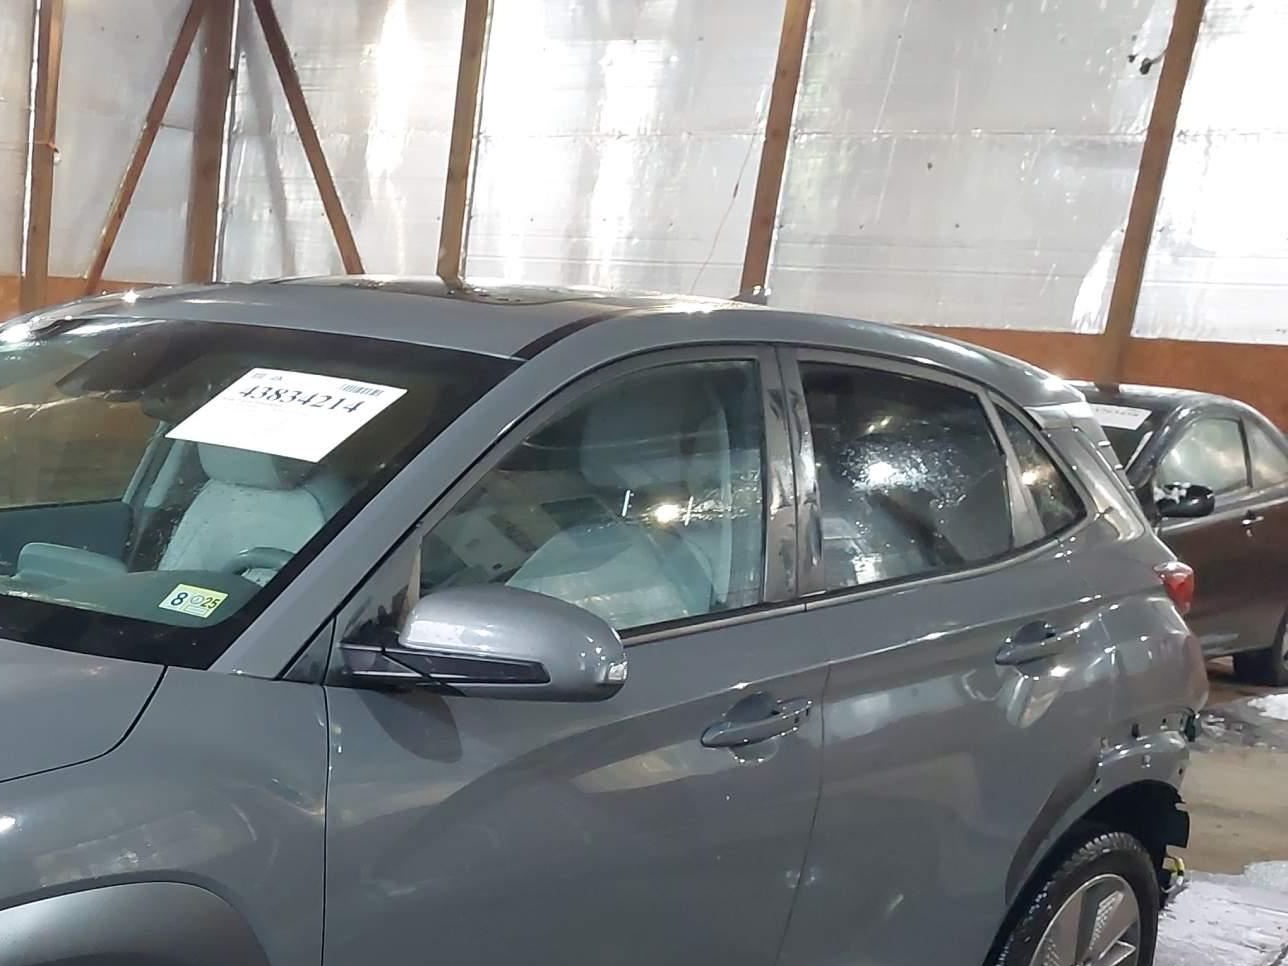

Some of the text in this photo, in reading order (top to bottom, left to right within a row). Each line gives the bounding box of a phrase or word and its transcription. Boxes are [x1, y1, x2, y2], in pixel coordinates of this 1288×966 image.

[239, 385, 365, 413] 43834214
[171, 592, 220, 609] 8 25
